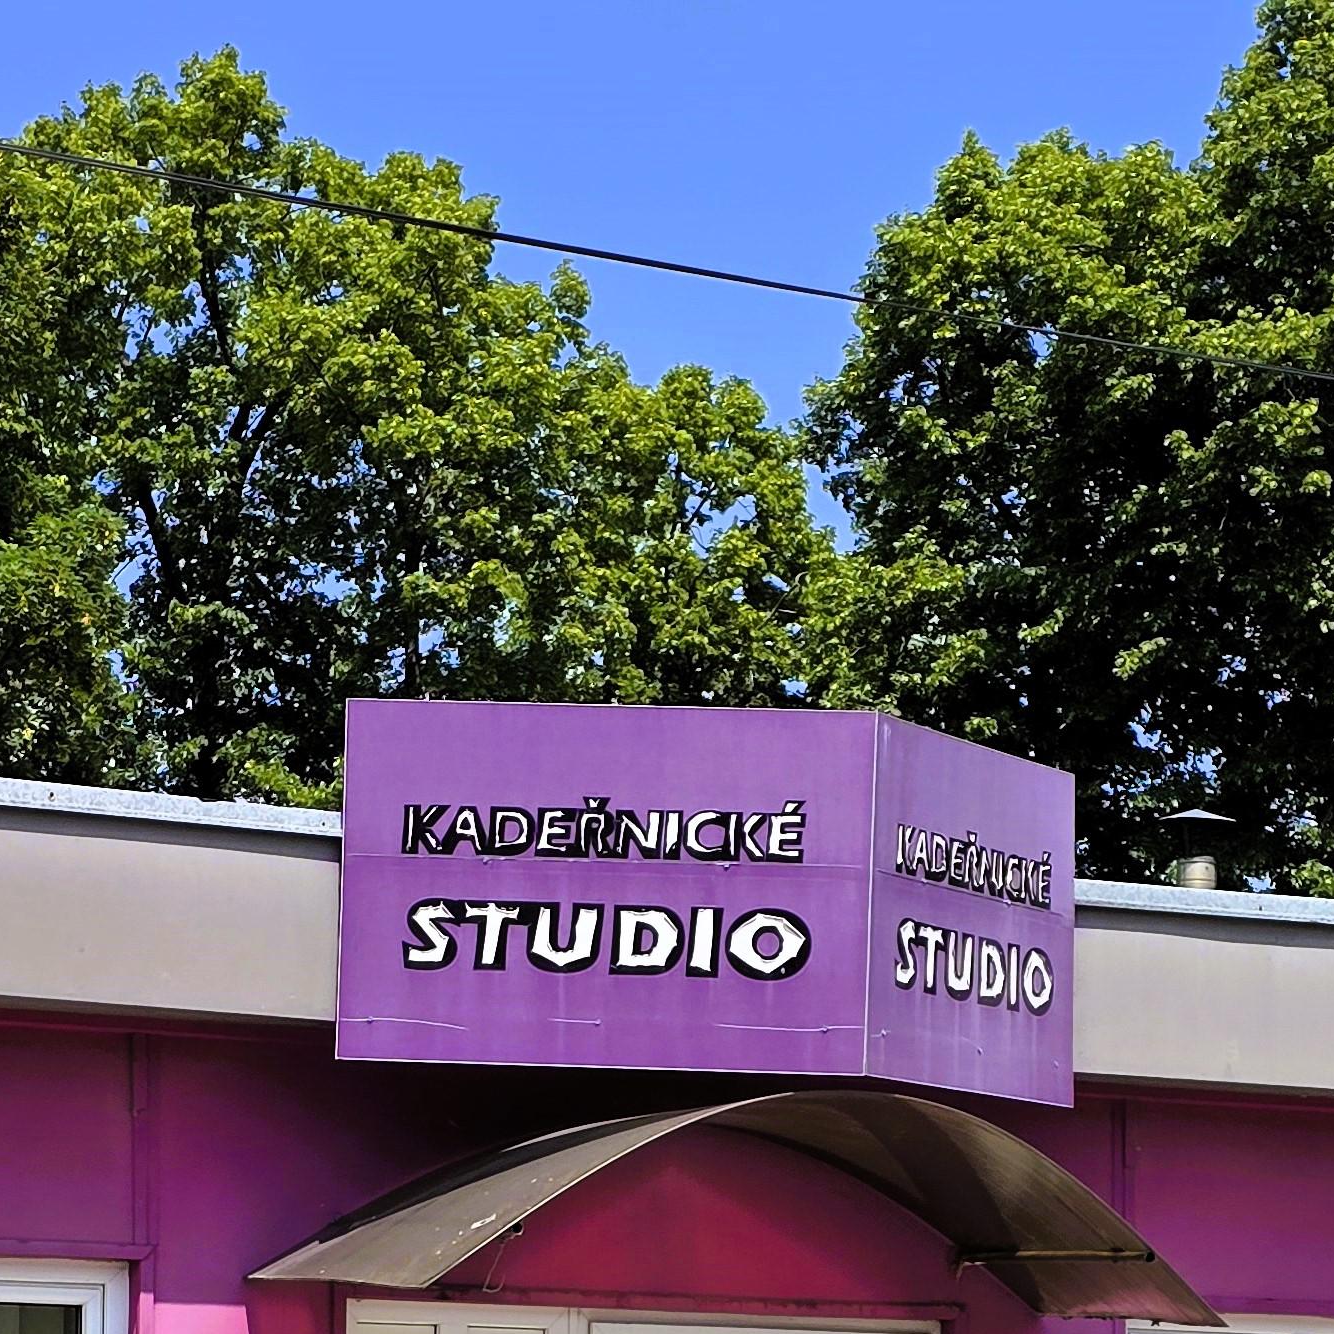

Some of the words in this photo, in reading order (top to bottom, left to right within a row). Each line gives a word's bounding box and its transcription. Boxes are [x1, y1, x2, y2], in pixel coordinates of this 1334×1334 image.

[402, 797, 806, 862] KADEŘNICKÉ
[894, 824, 1052, 908] KADEŘNICKÉ
[402, 899, 811, 981] STUDIO
[894, 918, 1054, 1016] STUDIO
